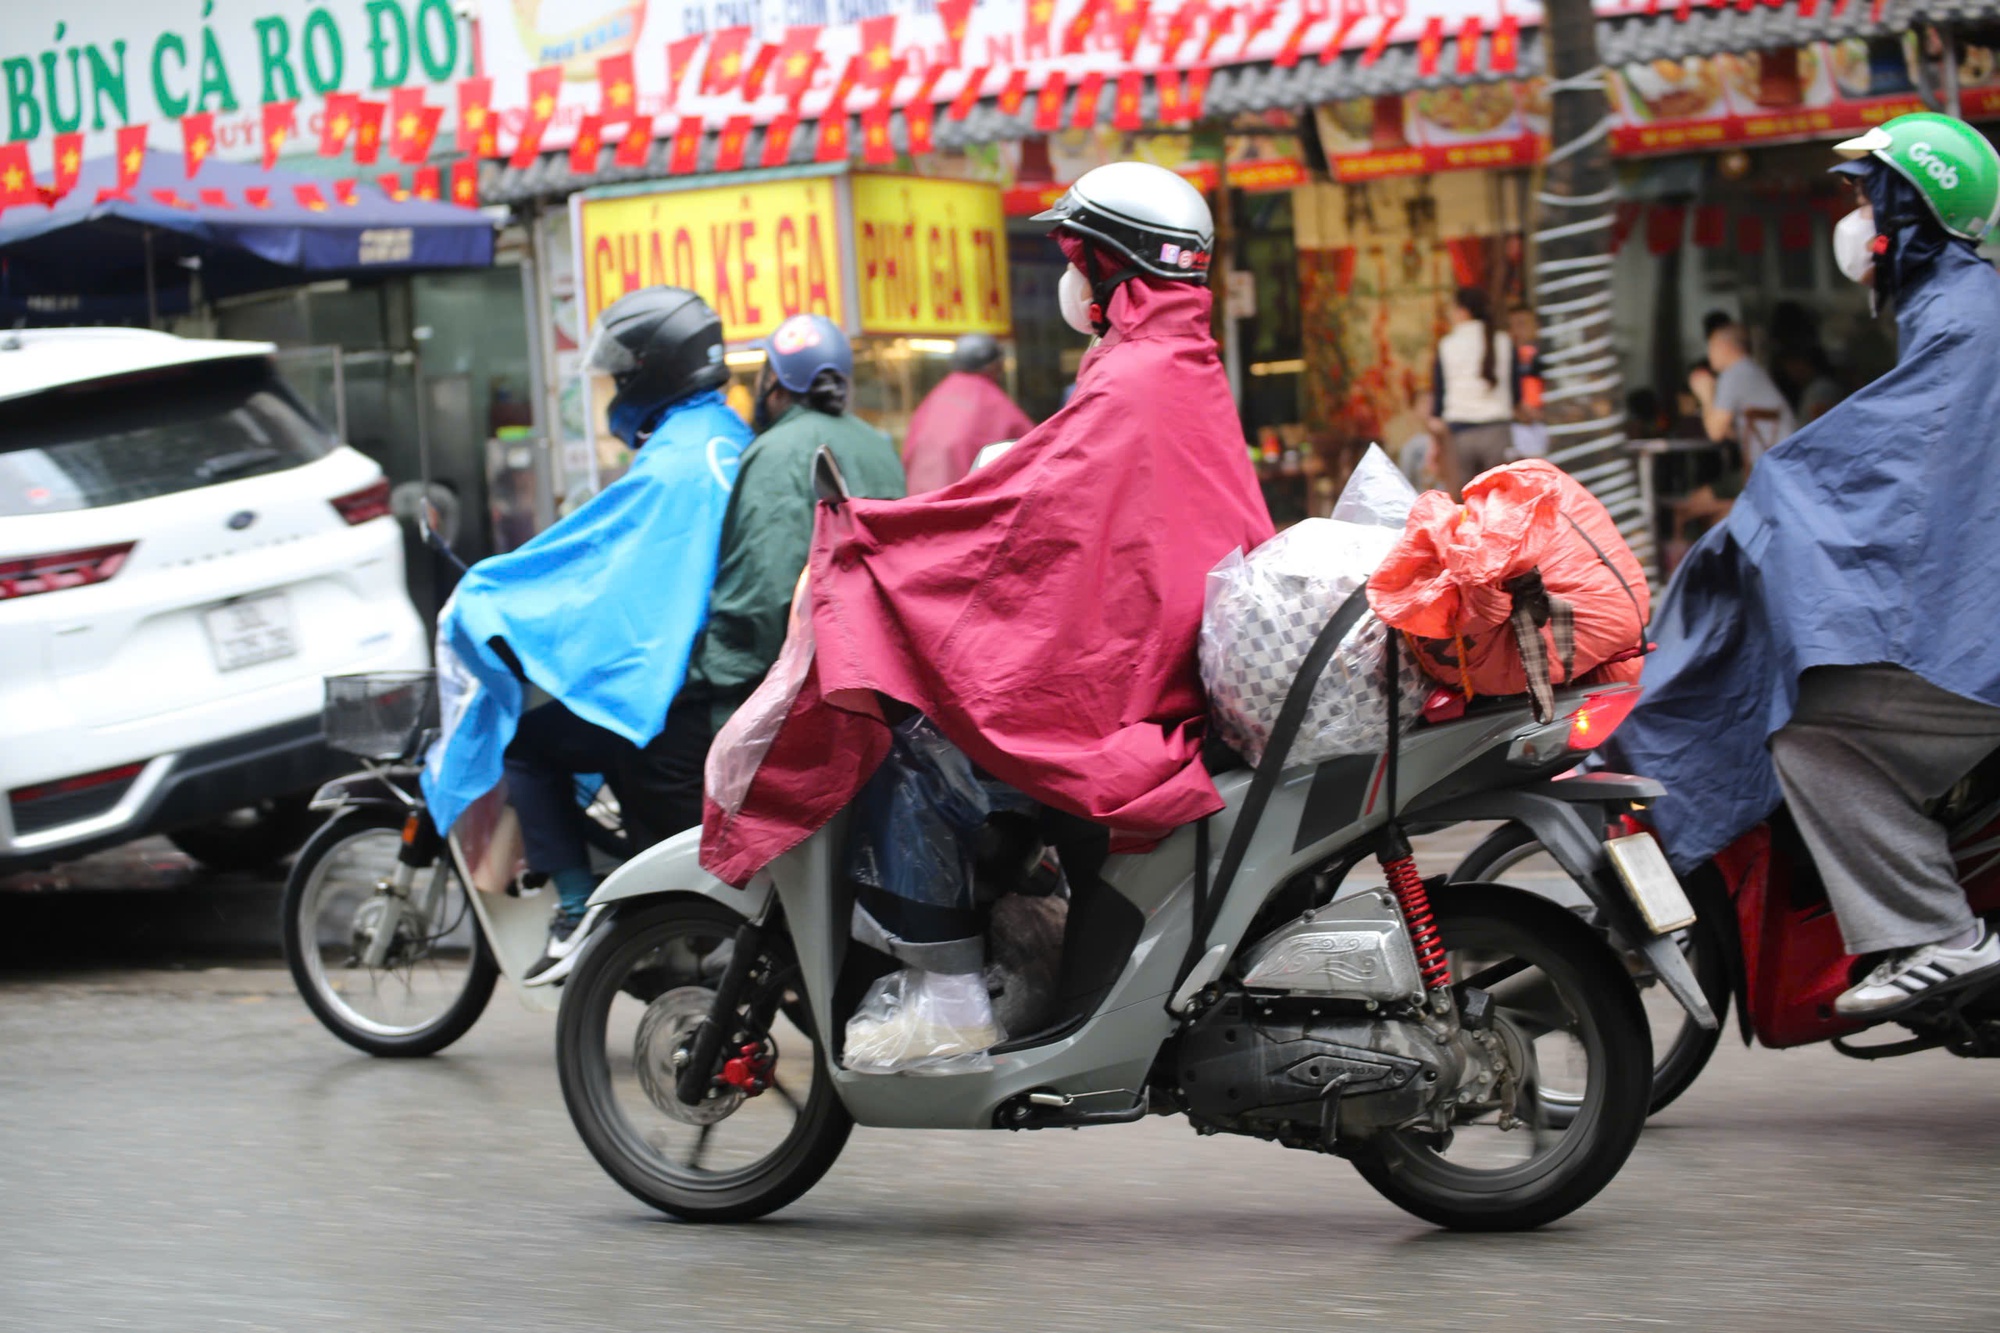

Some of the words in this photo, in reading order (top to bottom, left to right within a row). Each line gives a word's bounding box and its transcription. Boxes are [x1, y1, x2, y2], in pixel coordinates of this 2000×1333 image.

[1, 20, 129, 142] BÚN
[152, 0, 239, 119] CÁ
[1909, 141, 1959, 190] Grab
[711, 193, 760, 326] KÊ
[1325, 1065, 1377, 1076] HONDA
